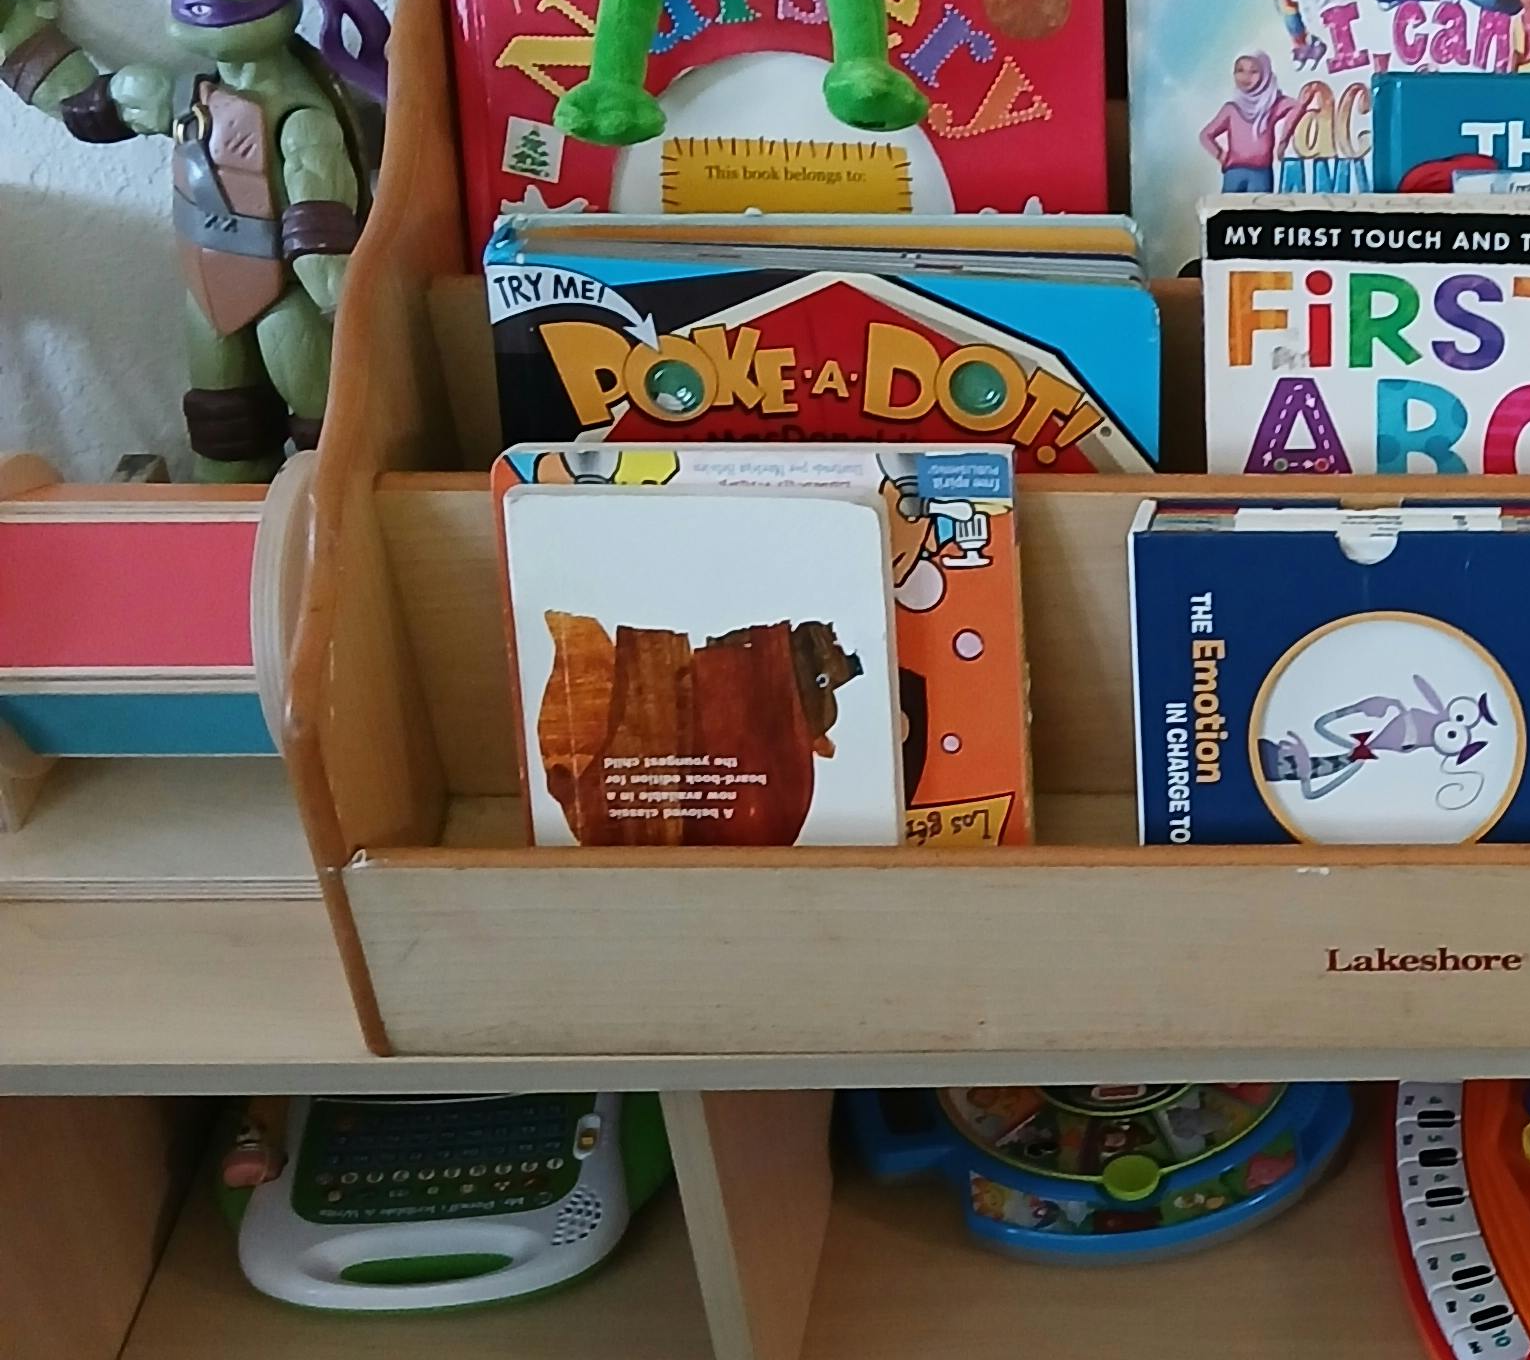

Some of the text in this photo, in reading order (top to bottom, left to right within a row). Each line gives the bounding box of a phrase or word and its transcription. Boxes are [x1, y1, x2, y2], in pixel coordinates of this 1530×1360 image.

[1319, 1, 1371, 74] I
[704, 164, 868, 187] This book belongs to:
[1224, 225, 1264, 247] MY
[1274, 227, 1341, 248] FIRST
[1351, 228, 1442, 250] TOUCH
[1452, 231, 1510, 252] AND
[491, 271, 607, 305] TRY ME!
[1189, 591, 1229, 785] THE Emotion
[603, 755, 738, 770] the youngest child
[1164, 702, 1192, 844] IN CHARGE TO
[604, 773, 768, 786] board-book edition for
[606, 791, 737, 803] now available in a
[608, 807, 734, 820] A beloved classic
[1324, 944, 1523, 972] Lakeshore
